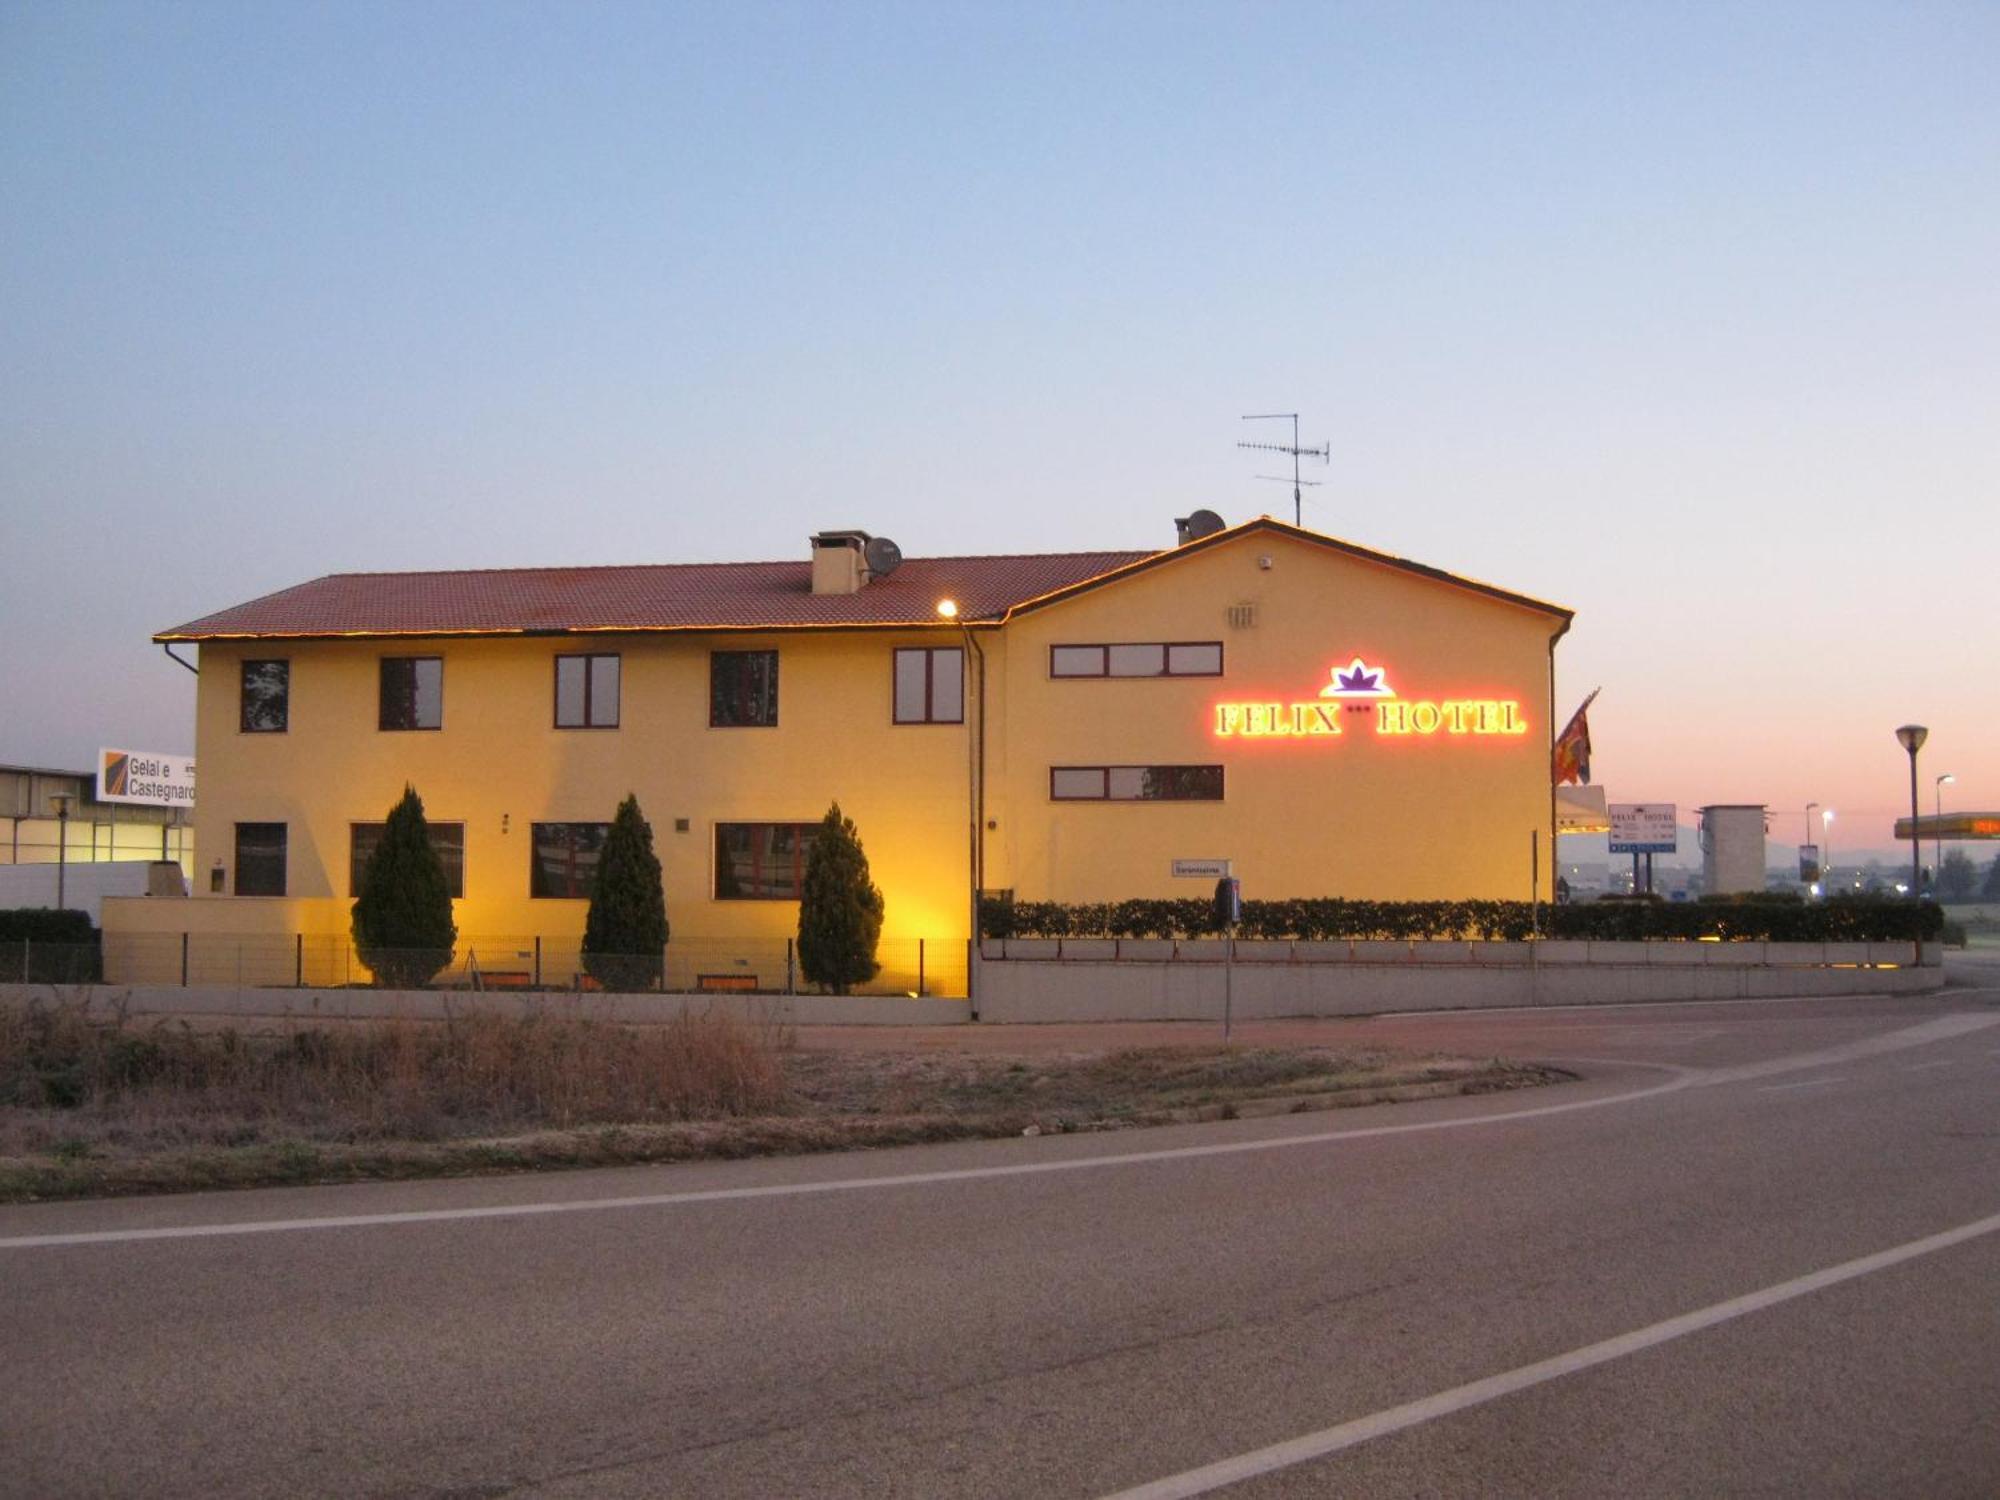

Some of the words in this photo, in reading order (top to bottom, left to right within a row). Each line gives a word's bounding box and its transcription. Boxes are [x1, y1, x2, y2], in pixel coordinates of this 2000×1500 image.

[1215, 703, 1342, 736] FELIX
[1376, 701, 1527, 735] HOTEL
[163, 765, 170, 778] e
[129, 779, 196, 801] Castegnaro
